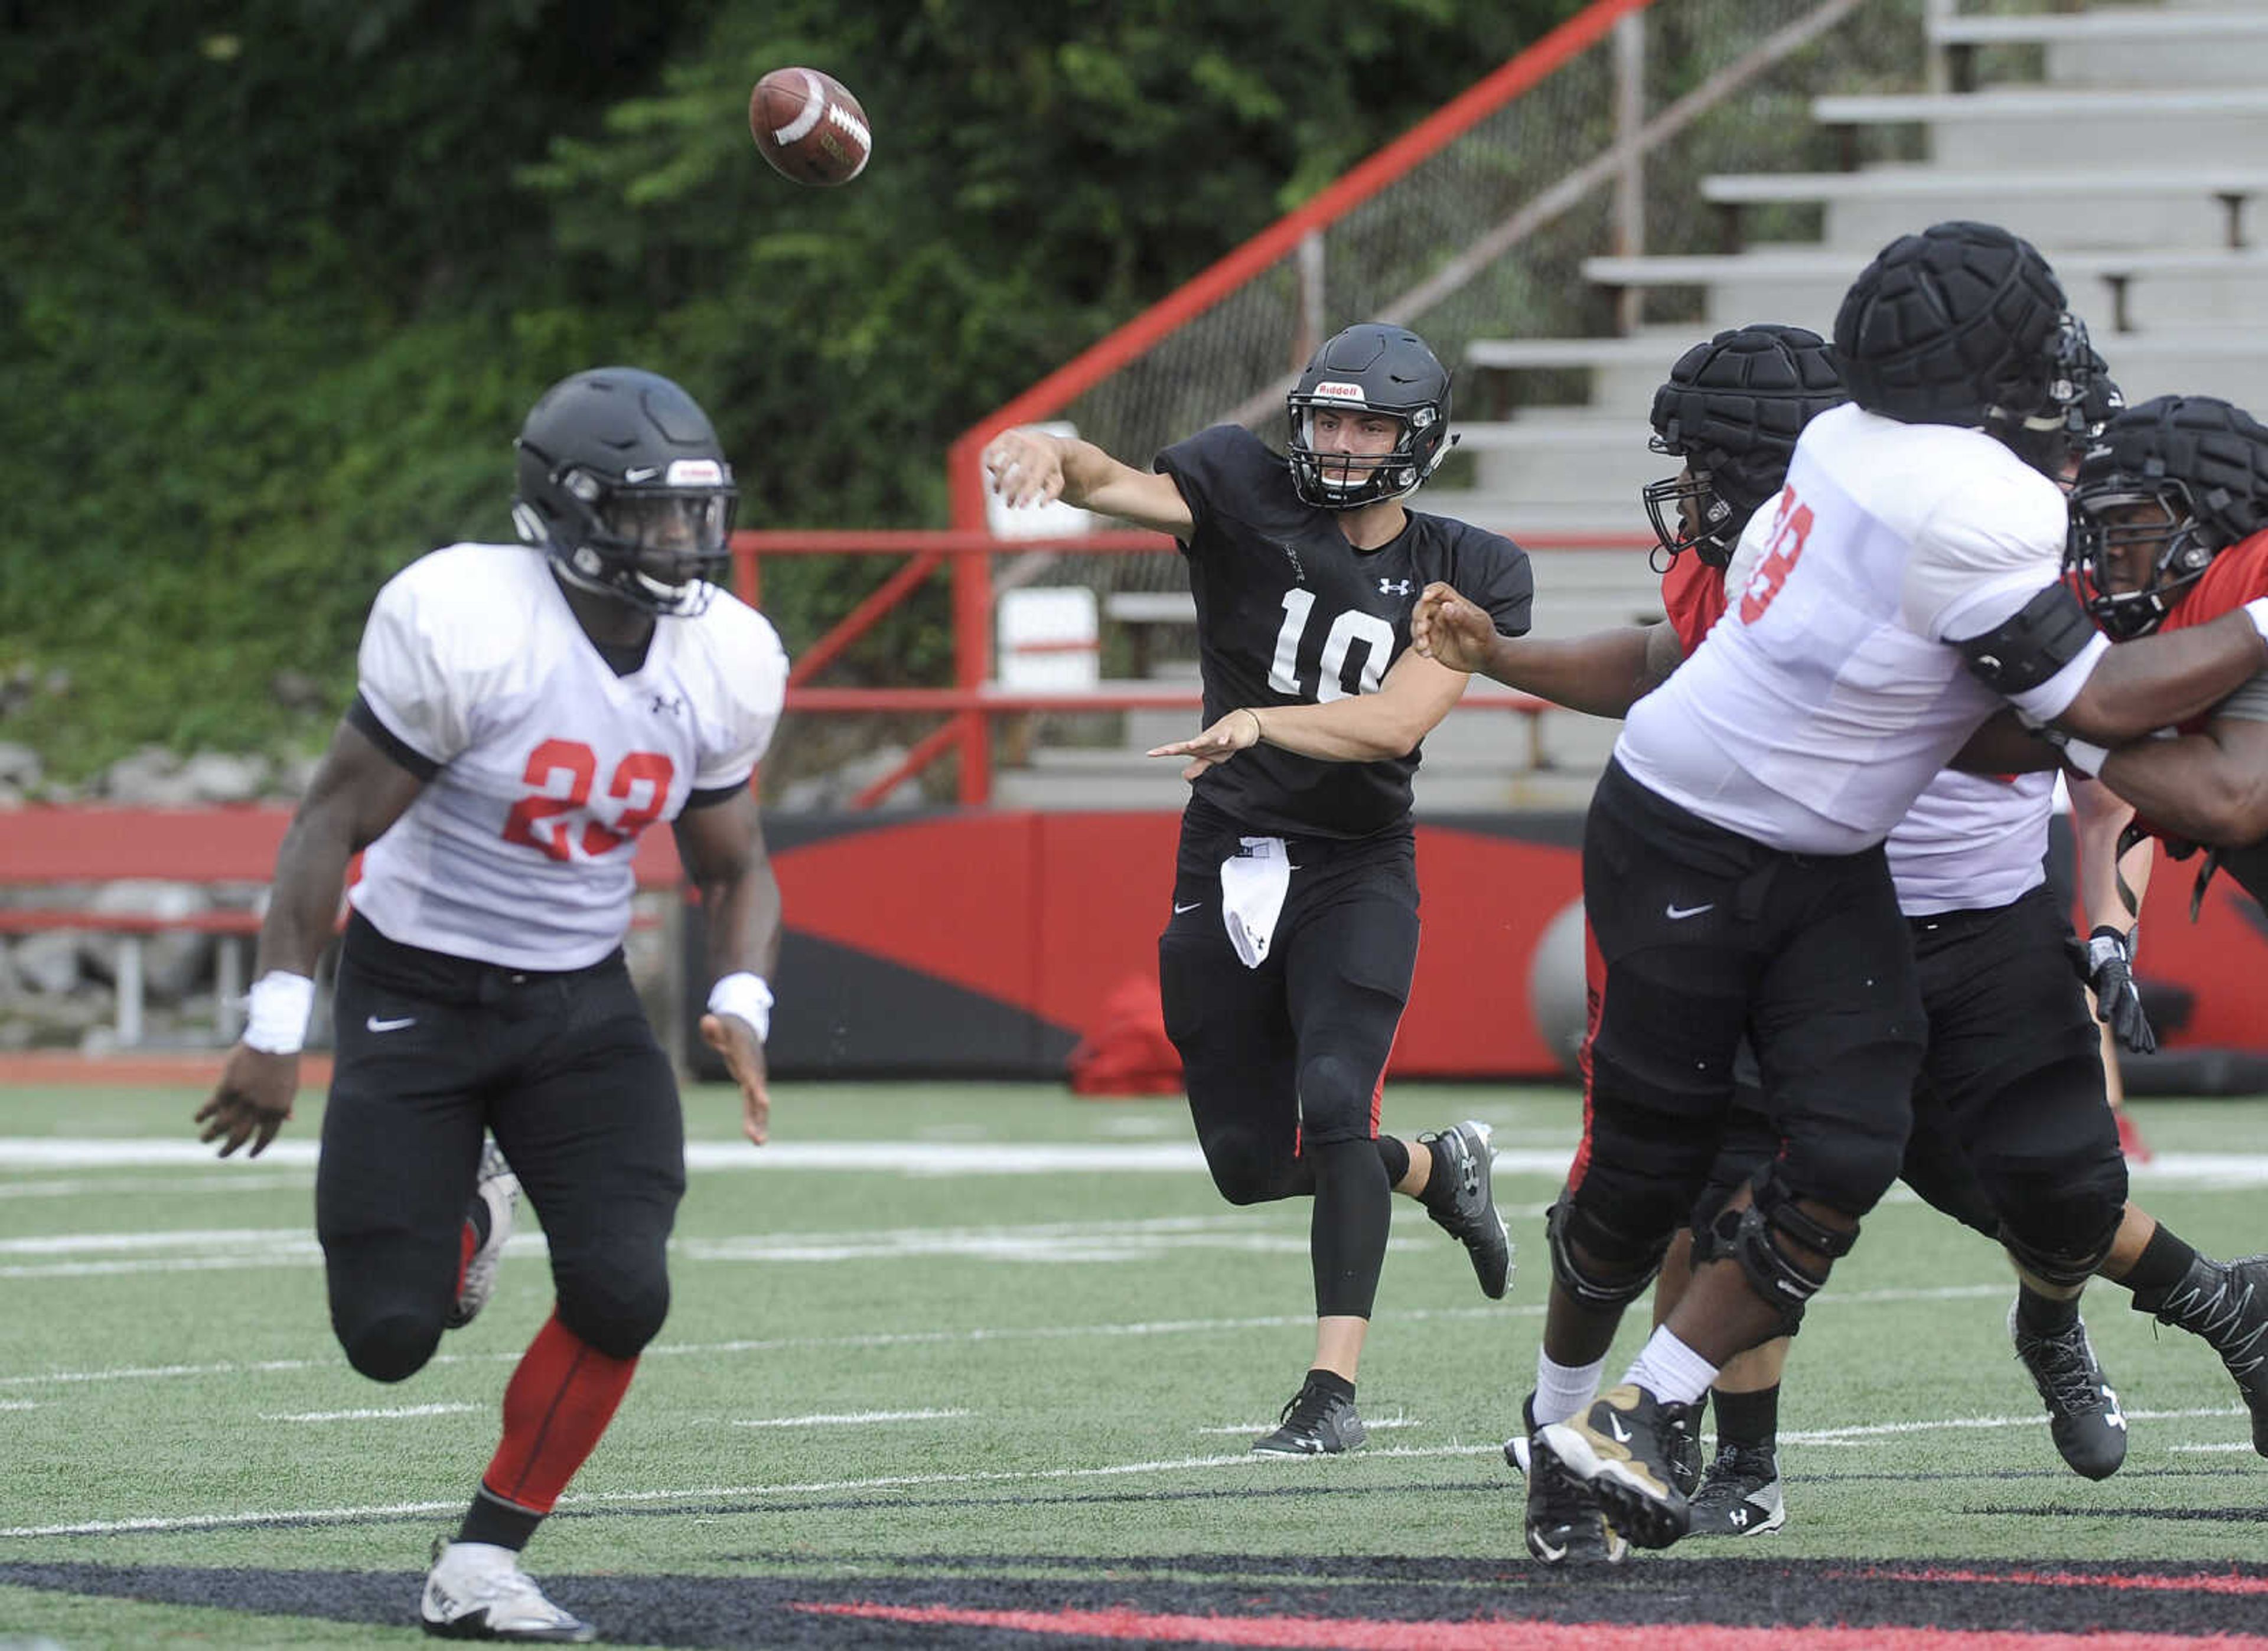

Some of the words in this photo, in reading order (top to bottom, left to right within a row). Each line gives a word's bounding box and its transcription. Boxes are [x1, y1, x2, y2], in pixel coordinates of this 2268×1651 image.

[1319, 385, 1357, 396] Riddell
[1268, 588, 1396, 704] 10
[502, 738, 674, 862] 23
